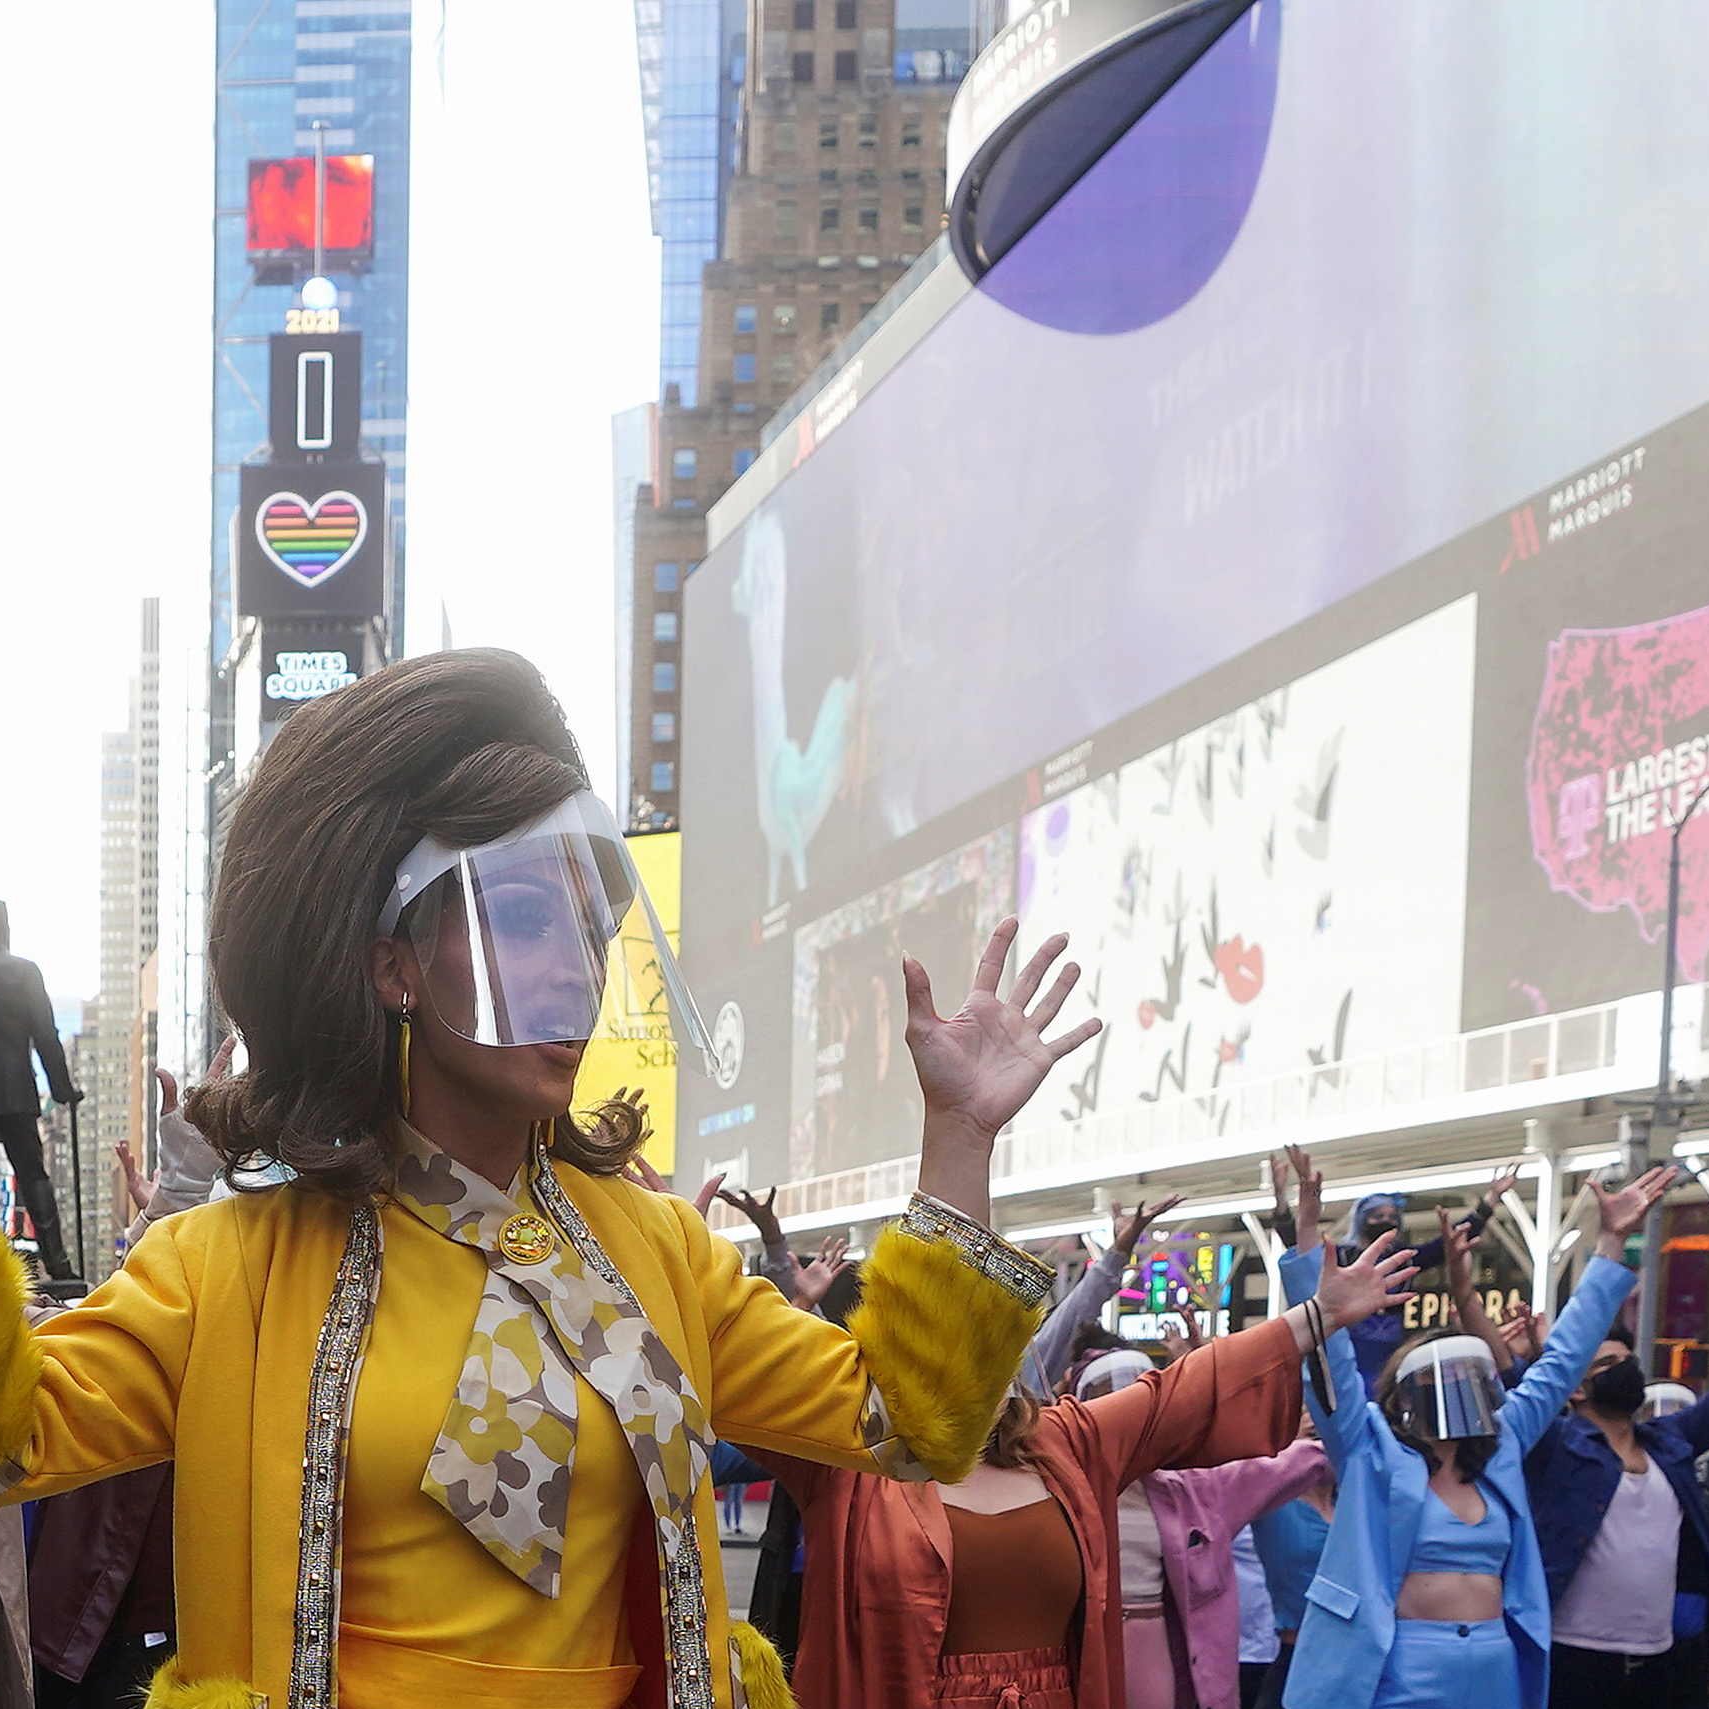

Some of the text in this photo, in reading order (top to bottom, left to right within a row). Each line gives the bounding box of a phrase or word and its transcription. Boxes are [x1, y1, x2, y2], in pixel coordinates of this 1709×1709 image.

[285, 309, 340, 333] 2021
[1548, 447, 1647, 512] MARRIOTT
[1547, 482, 1634, 542] MARQUIS
[279, 655, 343, 672] TIMES
[1606, 798, 1656, 844] THE
[1404, 1288, 1525, 1329] EPHRA
